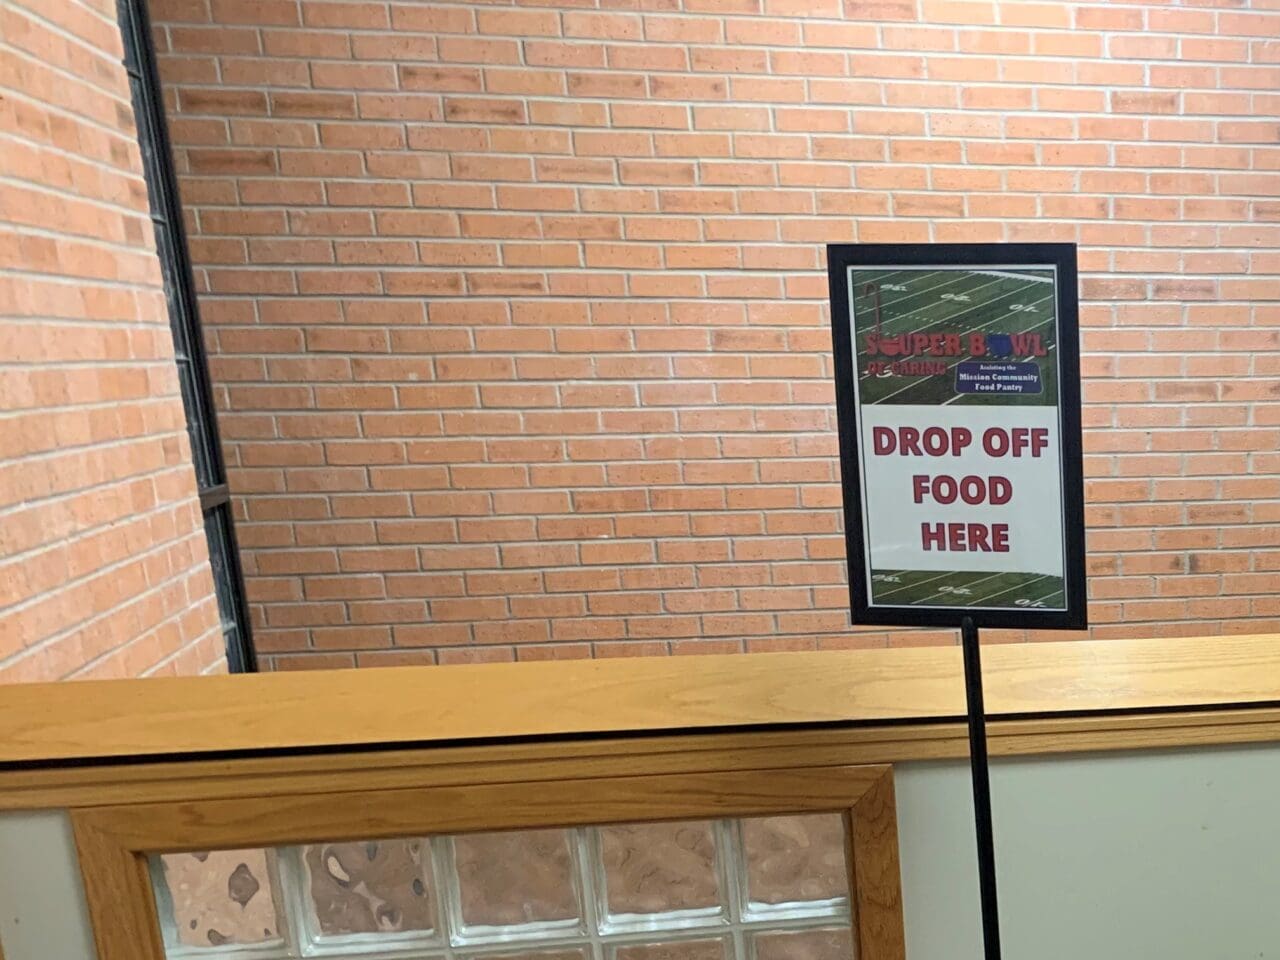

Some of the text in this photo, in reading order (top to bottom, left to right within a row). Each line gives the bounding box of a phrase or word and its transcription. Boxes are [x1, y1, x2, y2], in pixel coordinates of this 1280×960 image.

[959, 373, 1038, 383] Mission Community
[975, 383, 1023, 393] Food Pantry
[873, 426, 1049, 459] DROP OFF
[912, 475, 1013, 506] FOOD
[921, 522, 1010, 553] HERE
